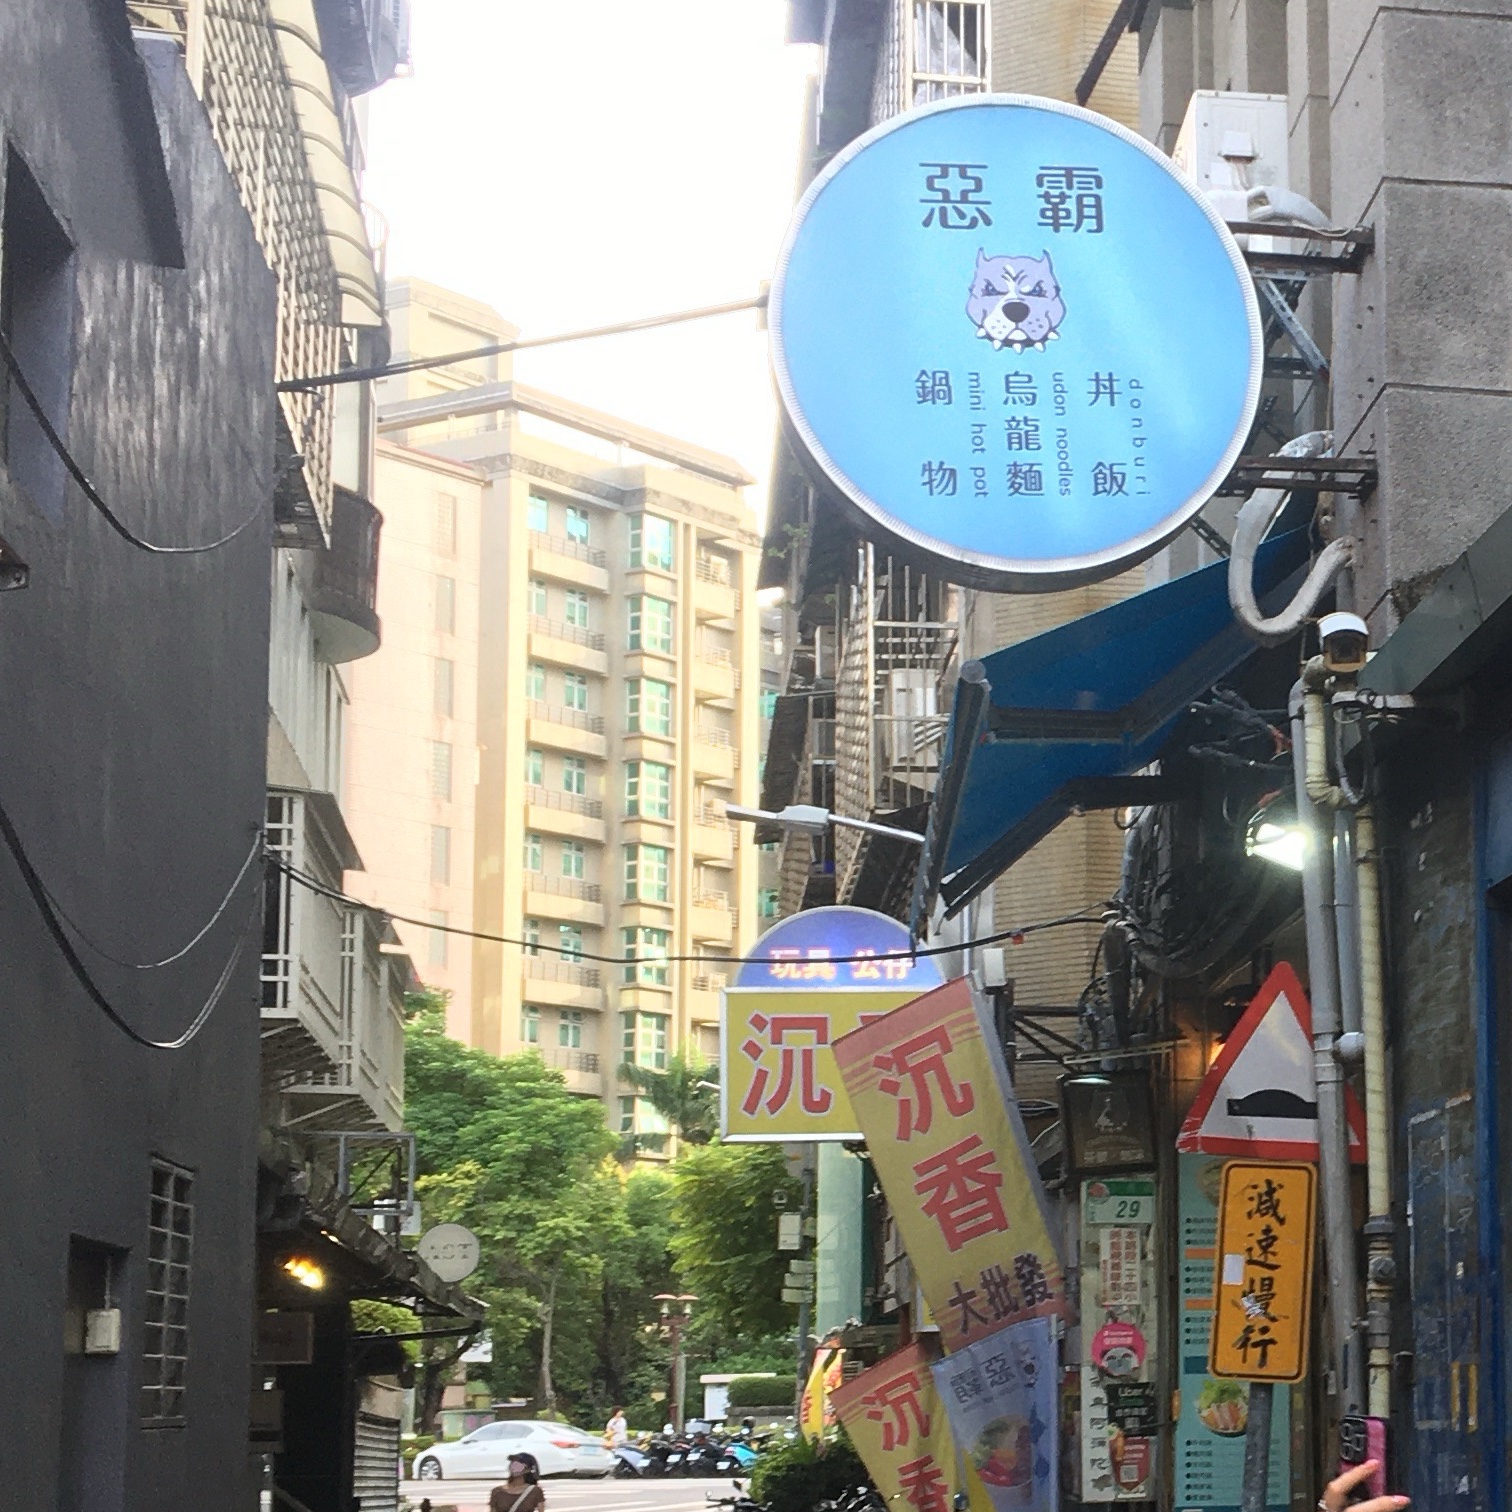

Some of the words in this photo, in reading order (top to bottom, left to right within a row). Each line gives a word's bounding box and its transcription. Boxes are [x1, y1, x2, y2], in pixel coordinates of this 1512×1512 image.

[918, 161, 1105, 234] 惡霸
[967, 371, 983, 411] mini
[1052, 371, 1068, 417] udon
[915, 369, 959, 498] 鍋物
[970, 423, 987, 455] hot
[1003, 370, 1045, 498] 烏龍麵
[1055, 427, 1074, 497] noodles
[1087, 370, 1130, 498] 丼飯
[1128, 378, 1152, 496] donburi
[970, 466, 990, 498] pot
[768, 948, 838, 980] 玩具
[741, 1013, 885, 1116] 沉
[872, 1023, 1010, 1253] 沉香
[1115, 1200, 1141, 1218] 29
[1232, 1178, 1290, 1369] 減速慢行
